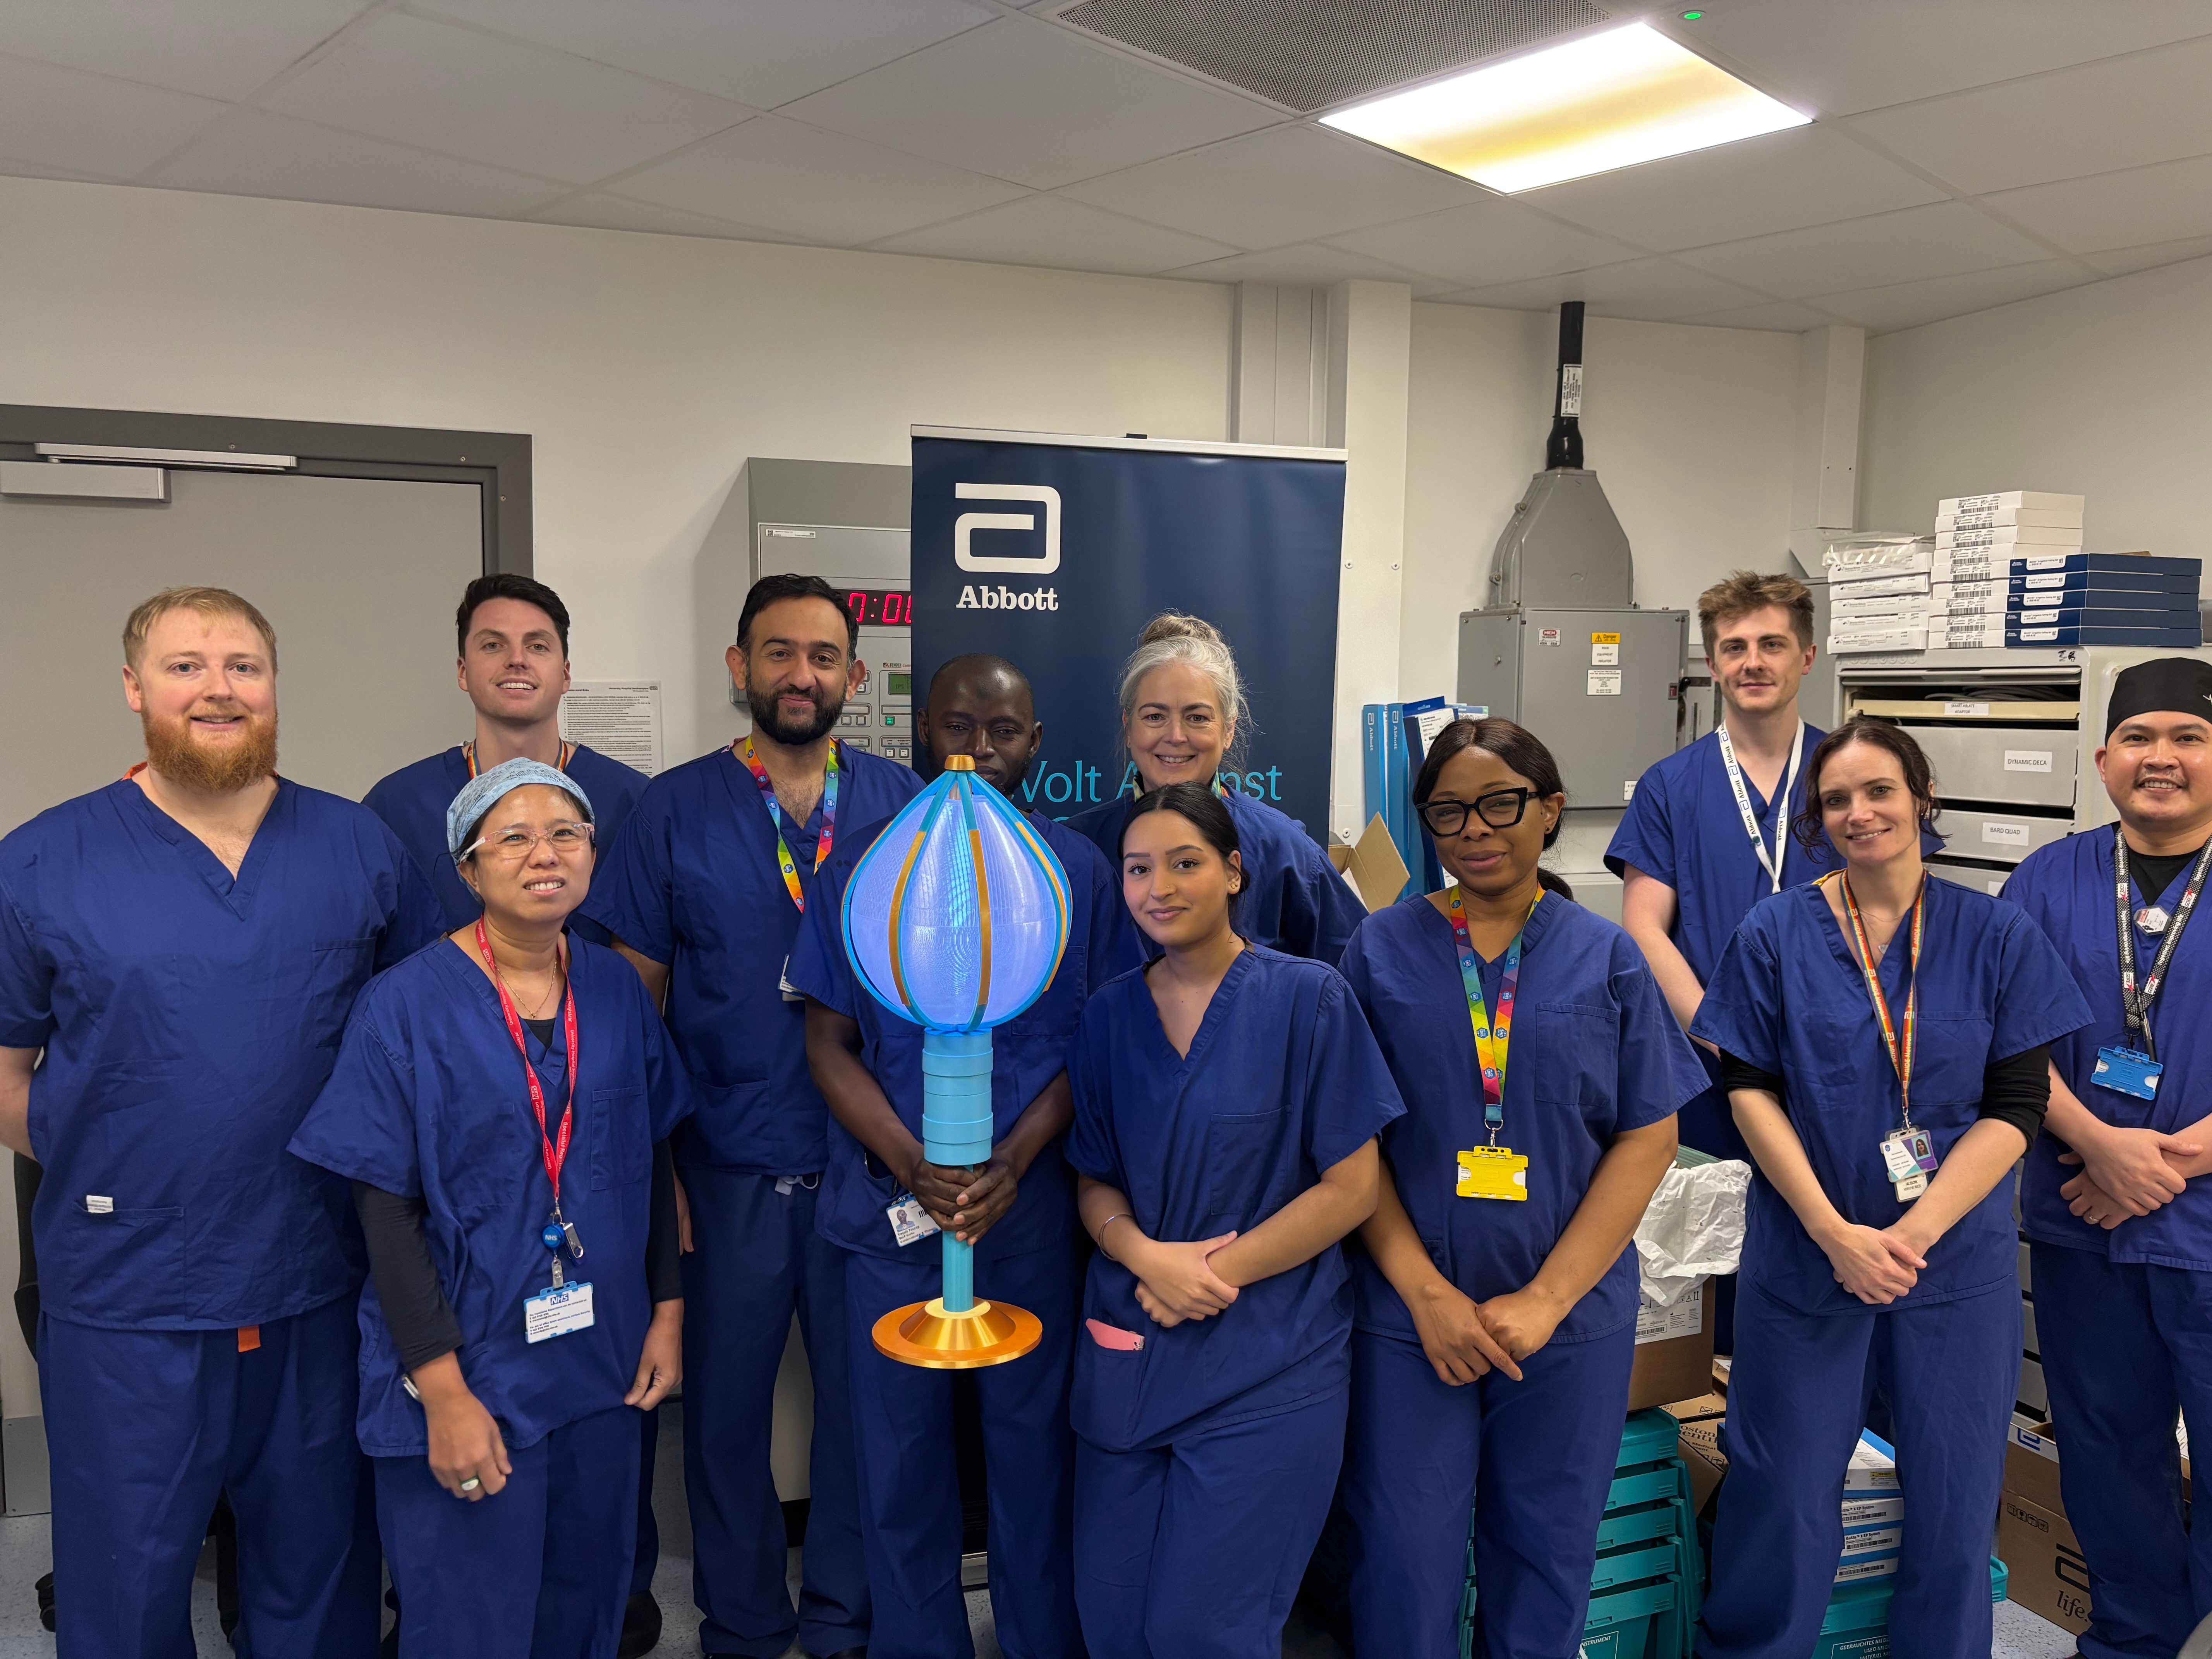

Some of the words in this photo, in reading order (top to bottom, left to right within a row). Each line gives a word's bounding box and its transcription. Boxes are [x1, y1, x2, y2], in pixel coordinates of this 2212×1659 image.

[956, 586, 1059, 611] Abbott
[1726, 745, 1735, 764] Abbott
[1734, 780, 1745, 799] Abbott
[1746, 814, 1757, 835] Abbott
[2166, 922, 2181, 945] improving
[1870, 980, 1879, 997] PRIDE
[1874, 996, 1887, 1020] Network
[551, 1295, 568, 1305] NHS
[1680, 1425, 1716, 1437] oston
[2057, 1590, 2088, 1622] life.
[1582, 1635, 1611, 1647] NSTRUMENT
[1840, 1640, 1874, 1650] GEBRAUCHTES
